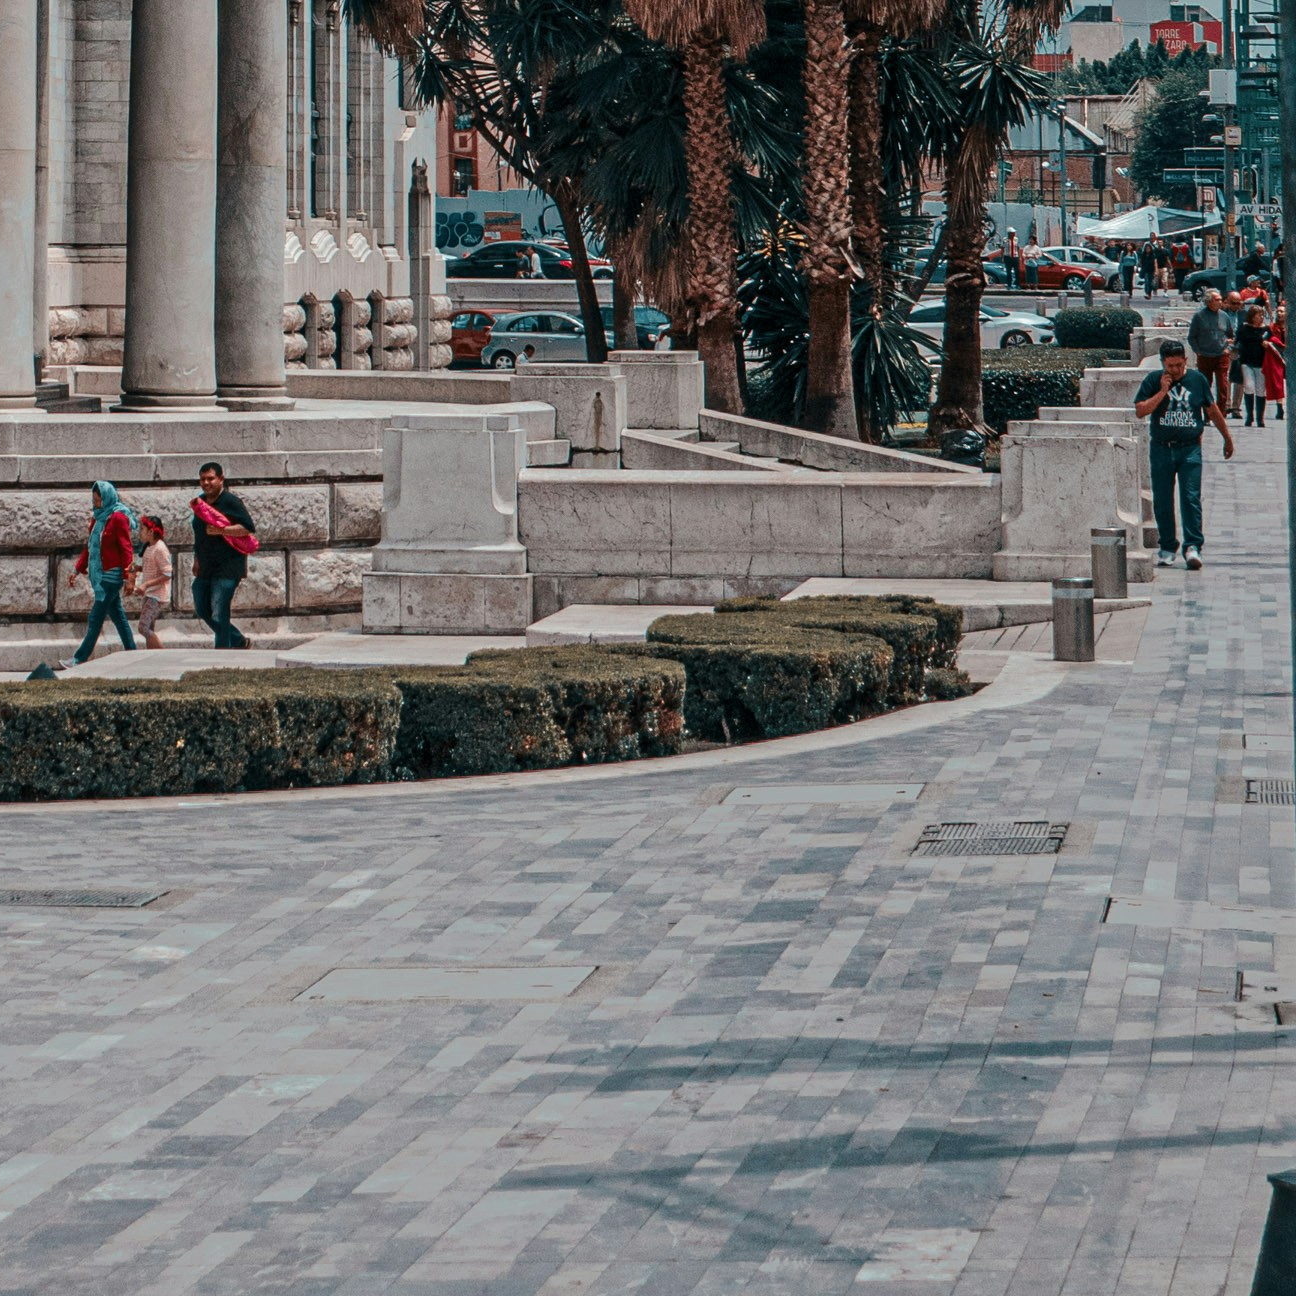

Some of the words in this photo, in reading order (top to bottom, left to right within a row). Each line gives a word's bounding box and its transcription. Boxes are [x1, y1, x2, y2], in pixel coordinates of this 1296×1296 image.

[1155, 28, 1181, 39] TORRE
[1165, 39, 1187, 50] ZARO
[1240, 205, 1254, 214] AV
